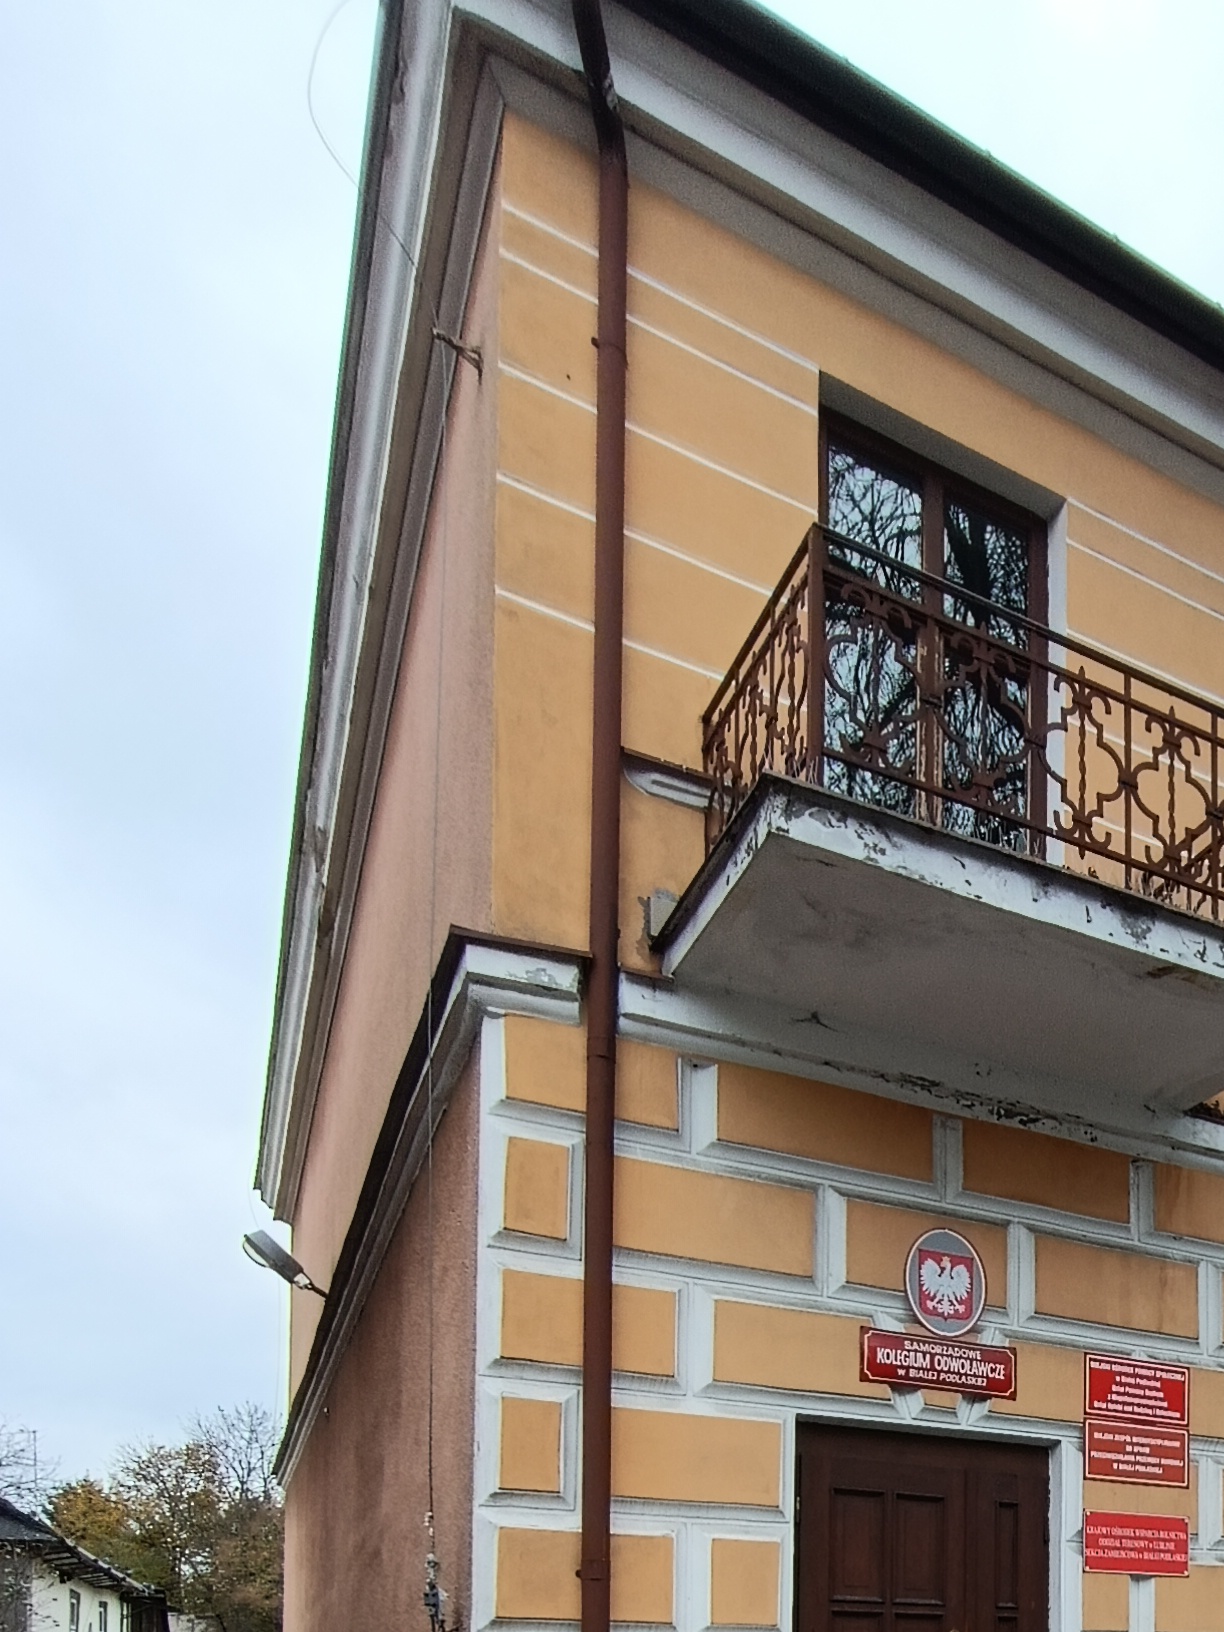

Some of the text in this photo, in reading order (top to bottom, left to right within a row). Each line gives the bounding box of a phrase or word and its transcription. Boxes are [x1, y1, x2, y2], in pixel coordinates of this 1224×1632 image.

[876, 1347, 1006, 1379] KOLEGIUM ODWOŁAWCZE
[939, 1373, 987, 1386] PODLASKIEJ
